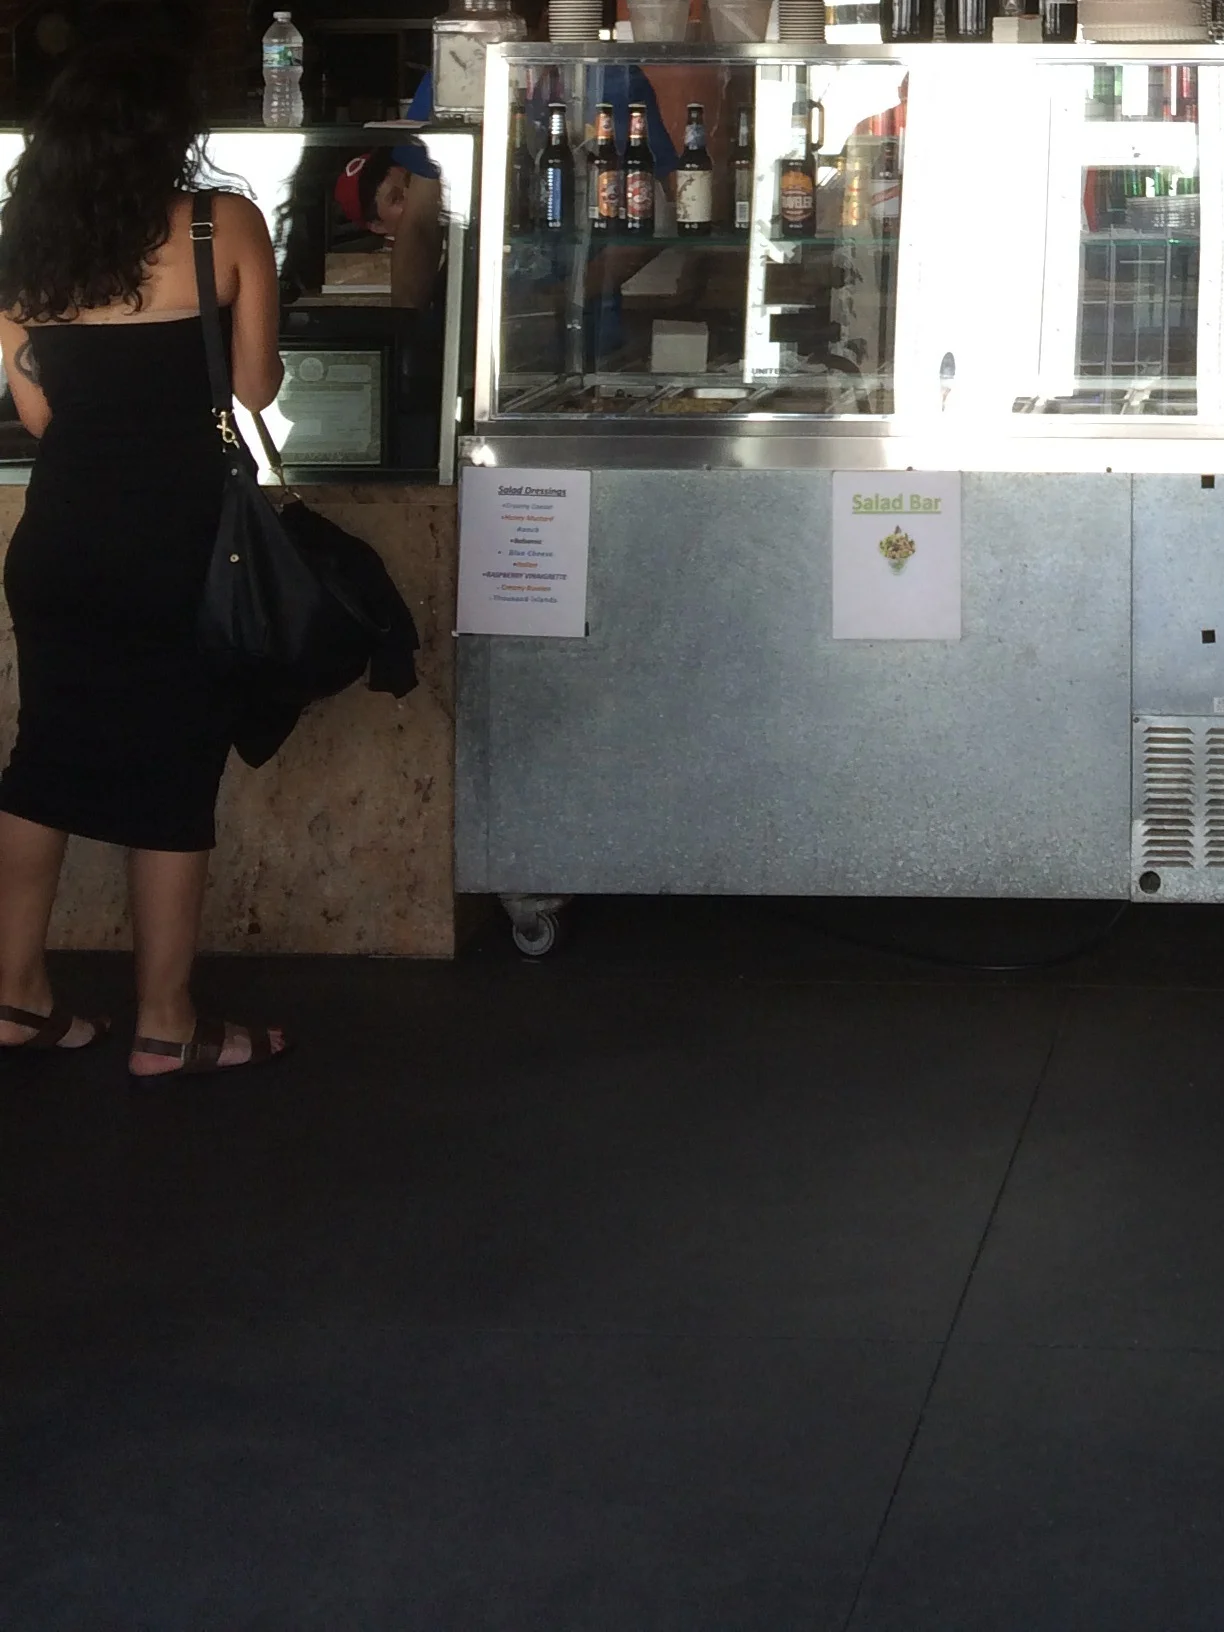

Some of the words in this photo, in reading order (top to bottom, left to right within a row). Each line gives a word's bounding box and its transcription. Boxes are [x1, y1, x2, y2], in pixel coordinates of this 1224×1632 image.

[498, 485, 523, 495] Salad
[525, 486, 567, 497] Dressings
[852, 493, 903, 512] Salad
[910, 494, 942, 512] Bar
